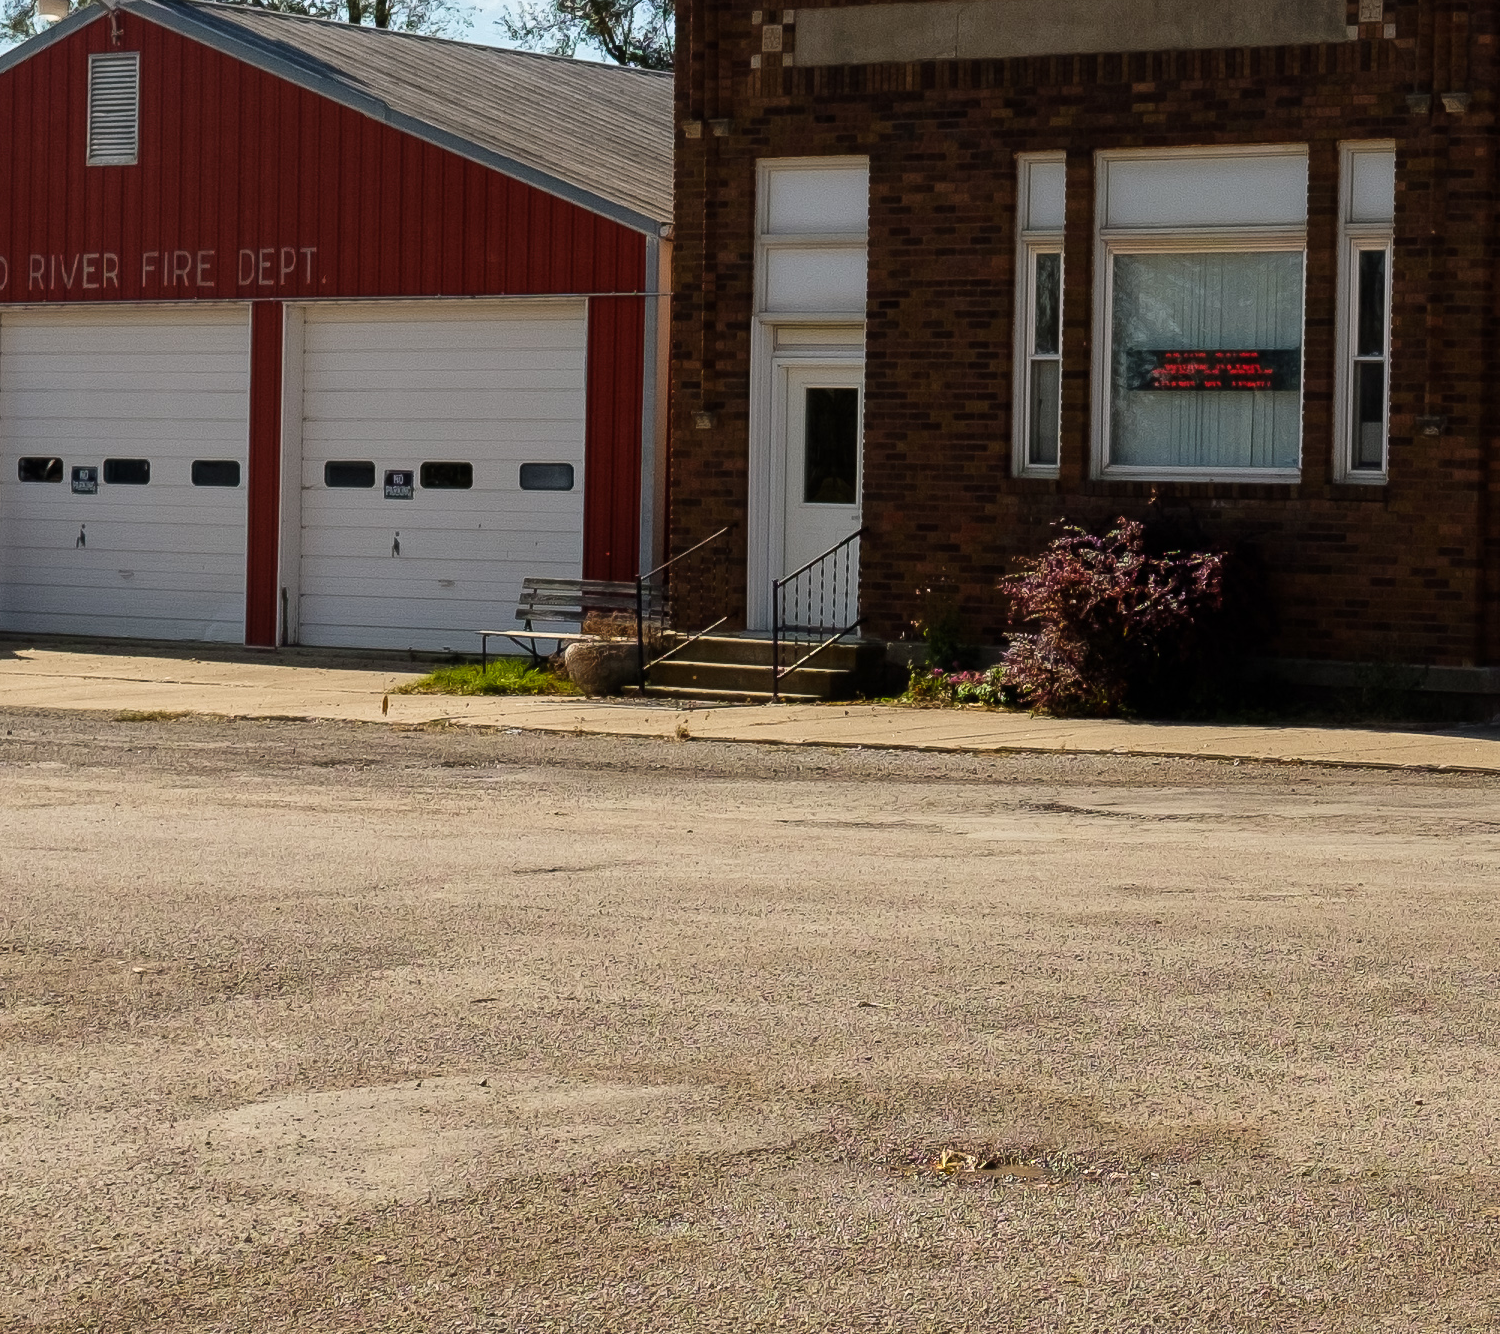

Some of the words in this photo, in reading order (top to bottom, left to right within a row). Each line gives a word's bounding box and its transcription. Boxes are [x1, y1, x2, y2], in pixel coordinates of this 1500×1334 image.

[29, 253, 119, 291] RIVER
[142, 249, 216, 288] FIRE
[238, 246, 328, 286] DEPT.
[393, 474, 404, 484] NO
